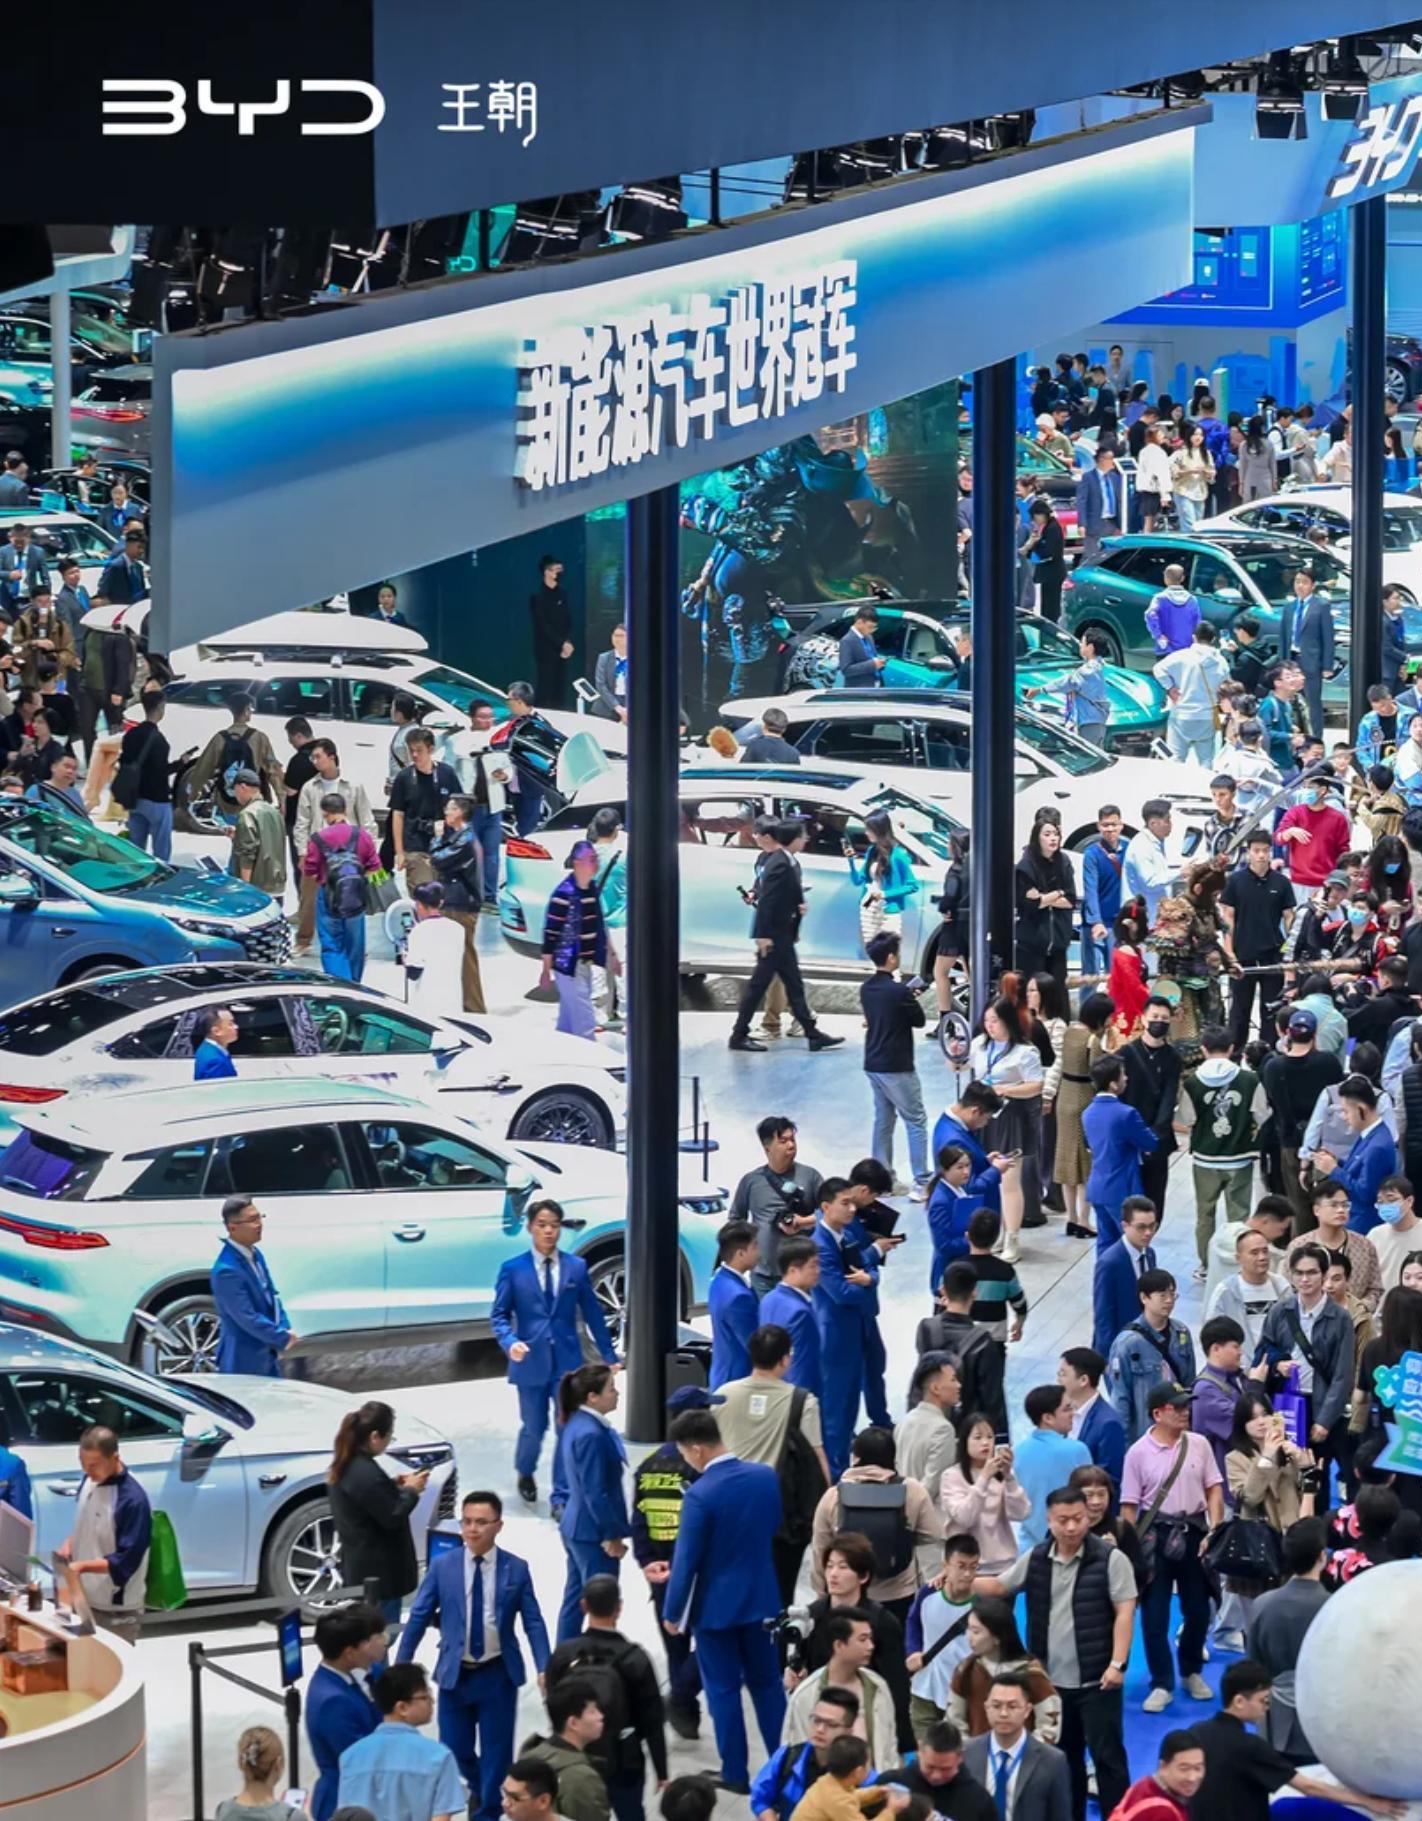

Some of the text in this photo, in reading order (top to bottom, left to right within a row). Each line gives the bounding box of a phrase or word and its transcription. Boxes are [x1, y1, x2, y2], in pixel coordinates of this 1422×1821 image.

[519, 260, 859, 491] 新能源汽车世界冠军
